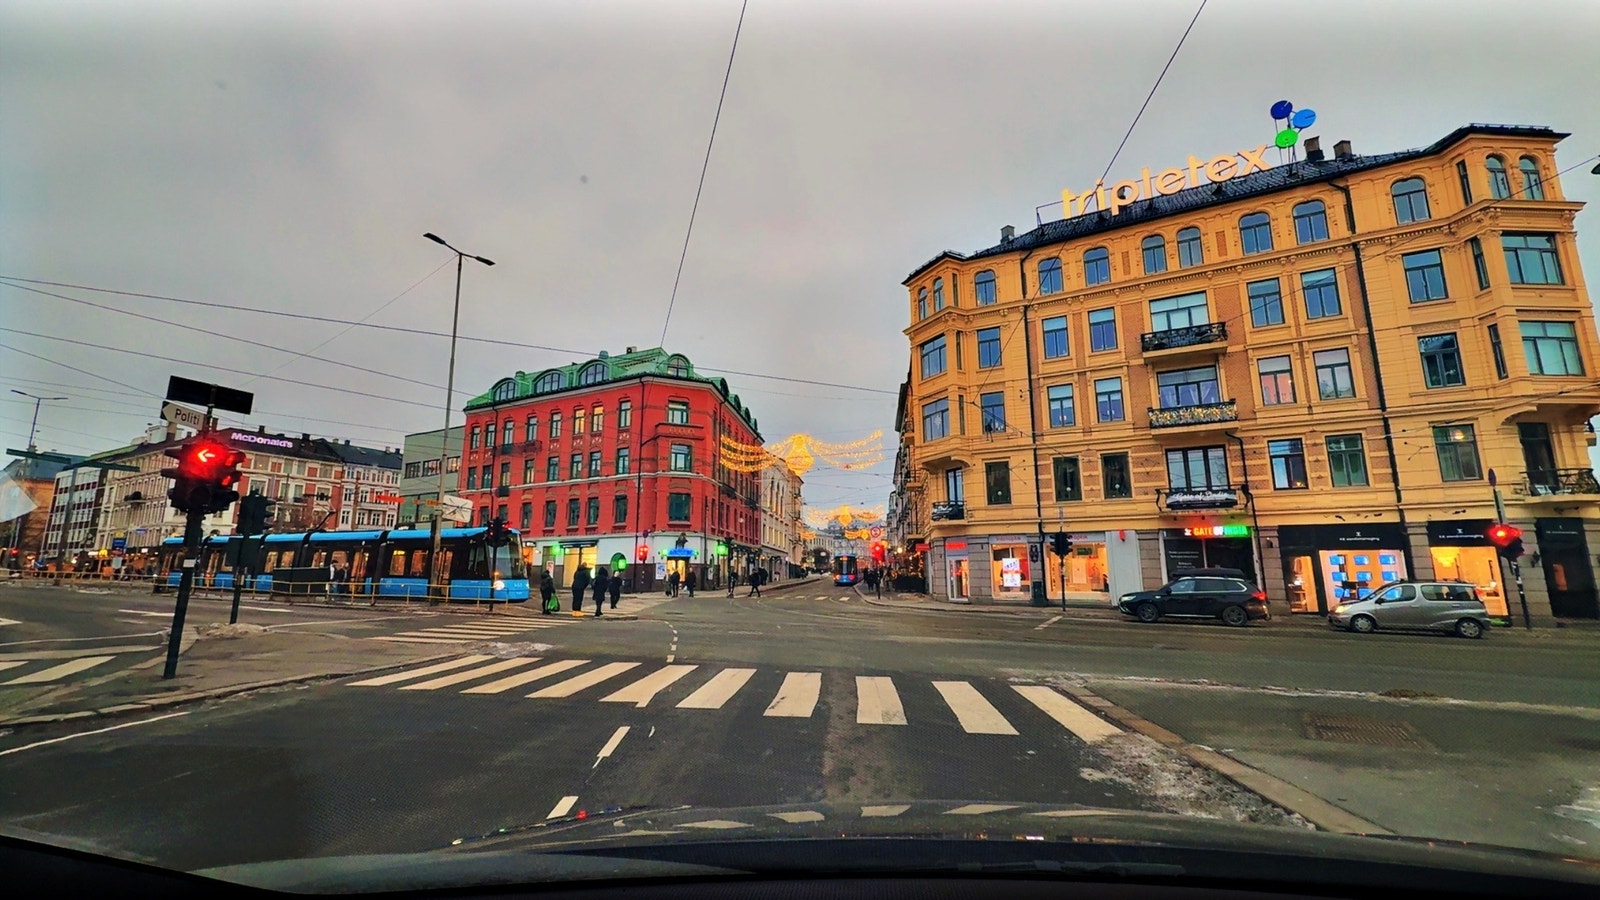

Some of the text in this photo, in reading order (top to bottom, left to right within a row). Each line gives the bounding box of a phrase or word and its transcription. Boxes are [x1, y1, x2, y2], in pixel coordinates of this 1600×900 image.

[1061, 144, 1272, 219] tripletex
[174, 408, 201, 426] Politi
[231, 432, 293, 449] McDonald's
[1193, 527, 1212, 536] GATE
